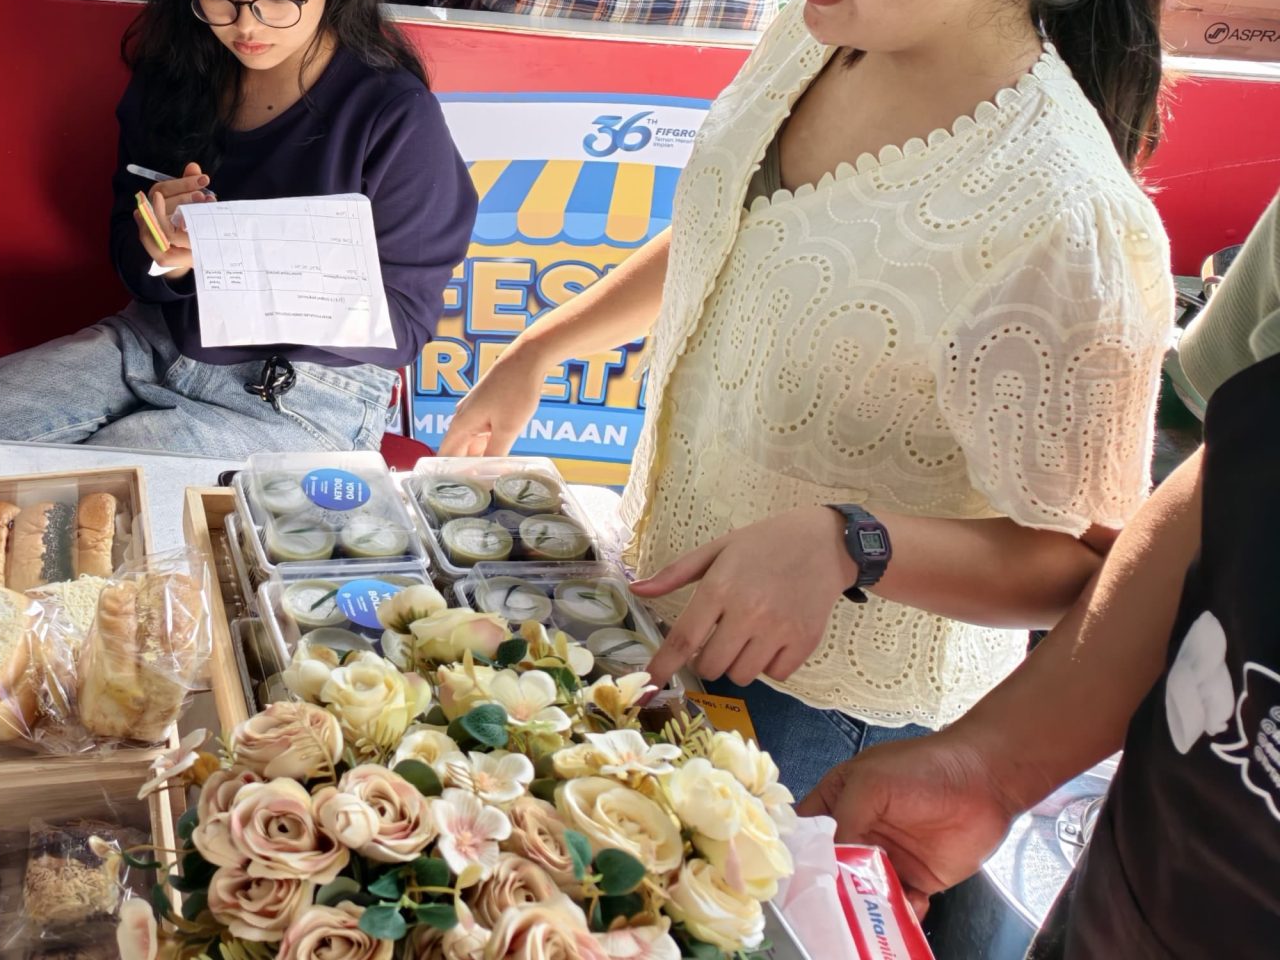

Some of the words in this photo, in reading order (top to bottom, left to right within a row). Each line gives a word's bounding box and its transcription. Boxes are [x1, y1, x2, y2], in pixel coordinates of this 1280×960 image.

[583, 111, 655, 158] 36
[655, 128, 696, 138] FIFGRO
[519, 420, 627, 446] INAAN
[334, 477, 343, 501] BOLEN
[345, 482, 355, 500] YOYO
